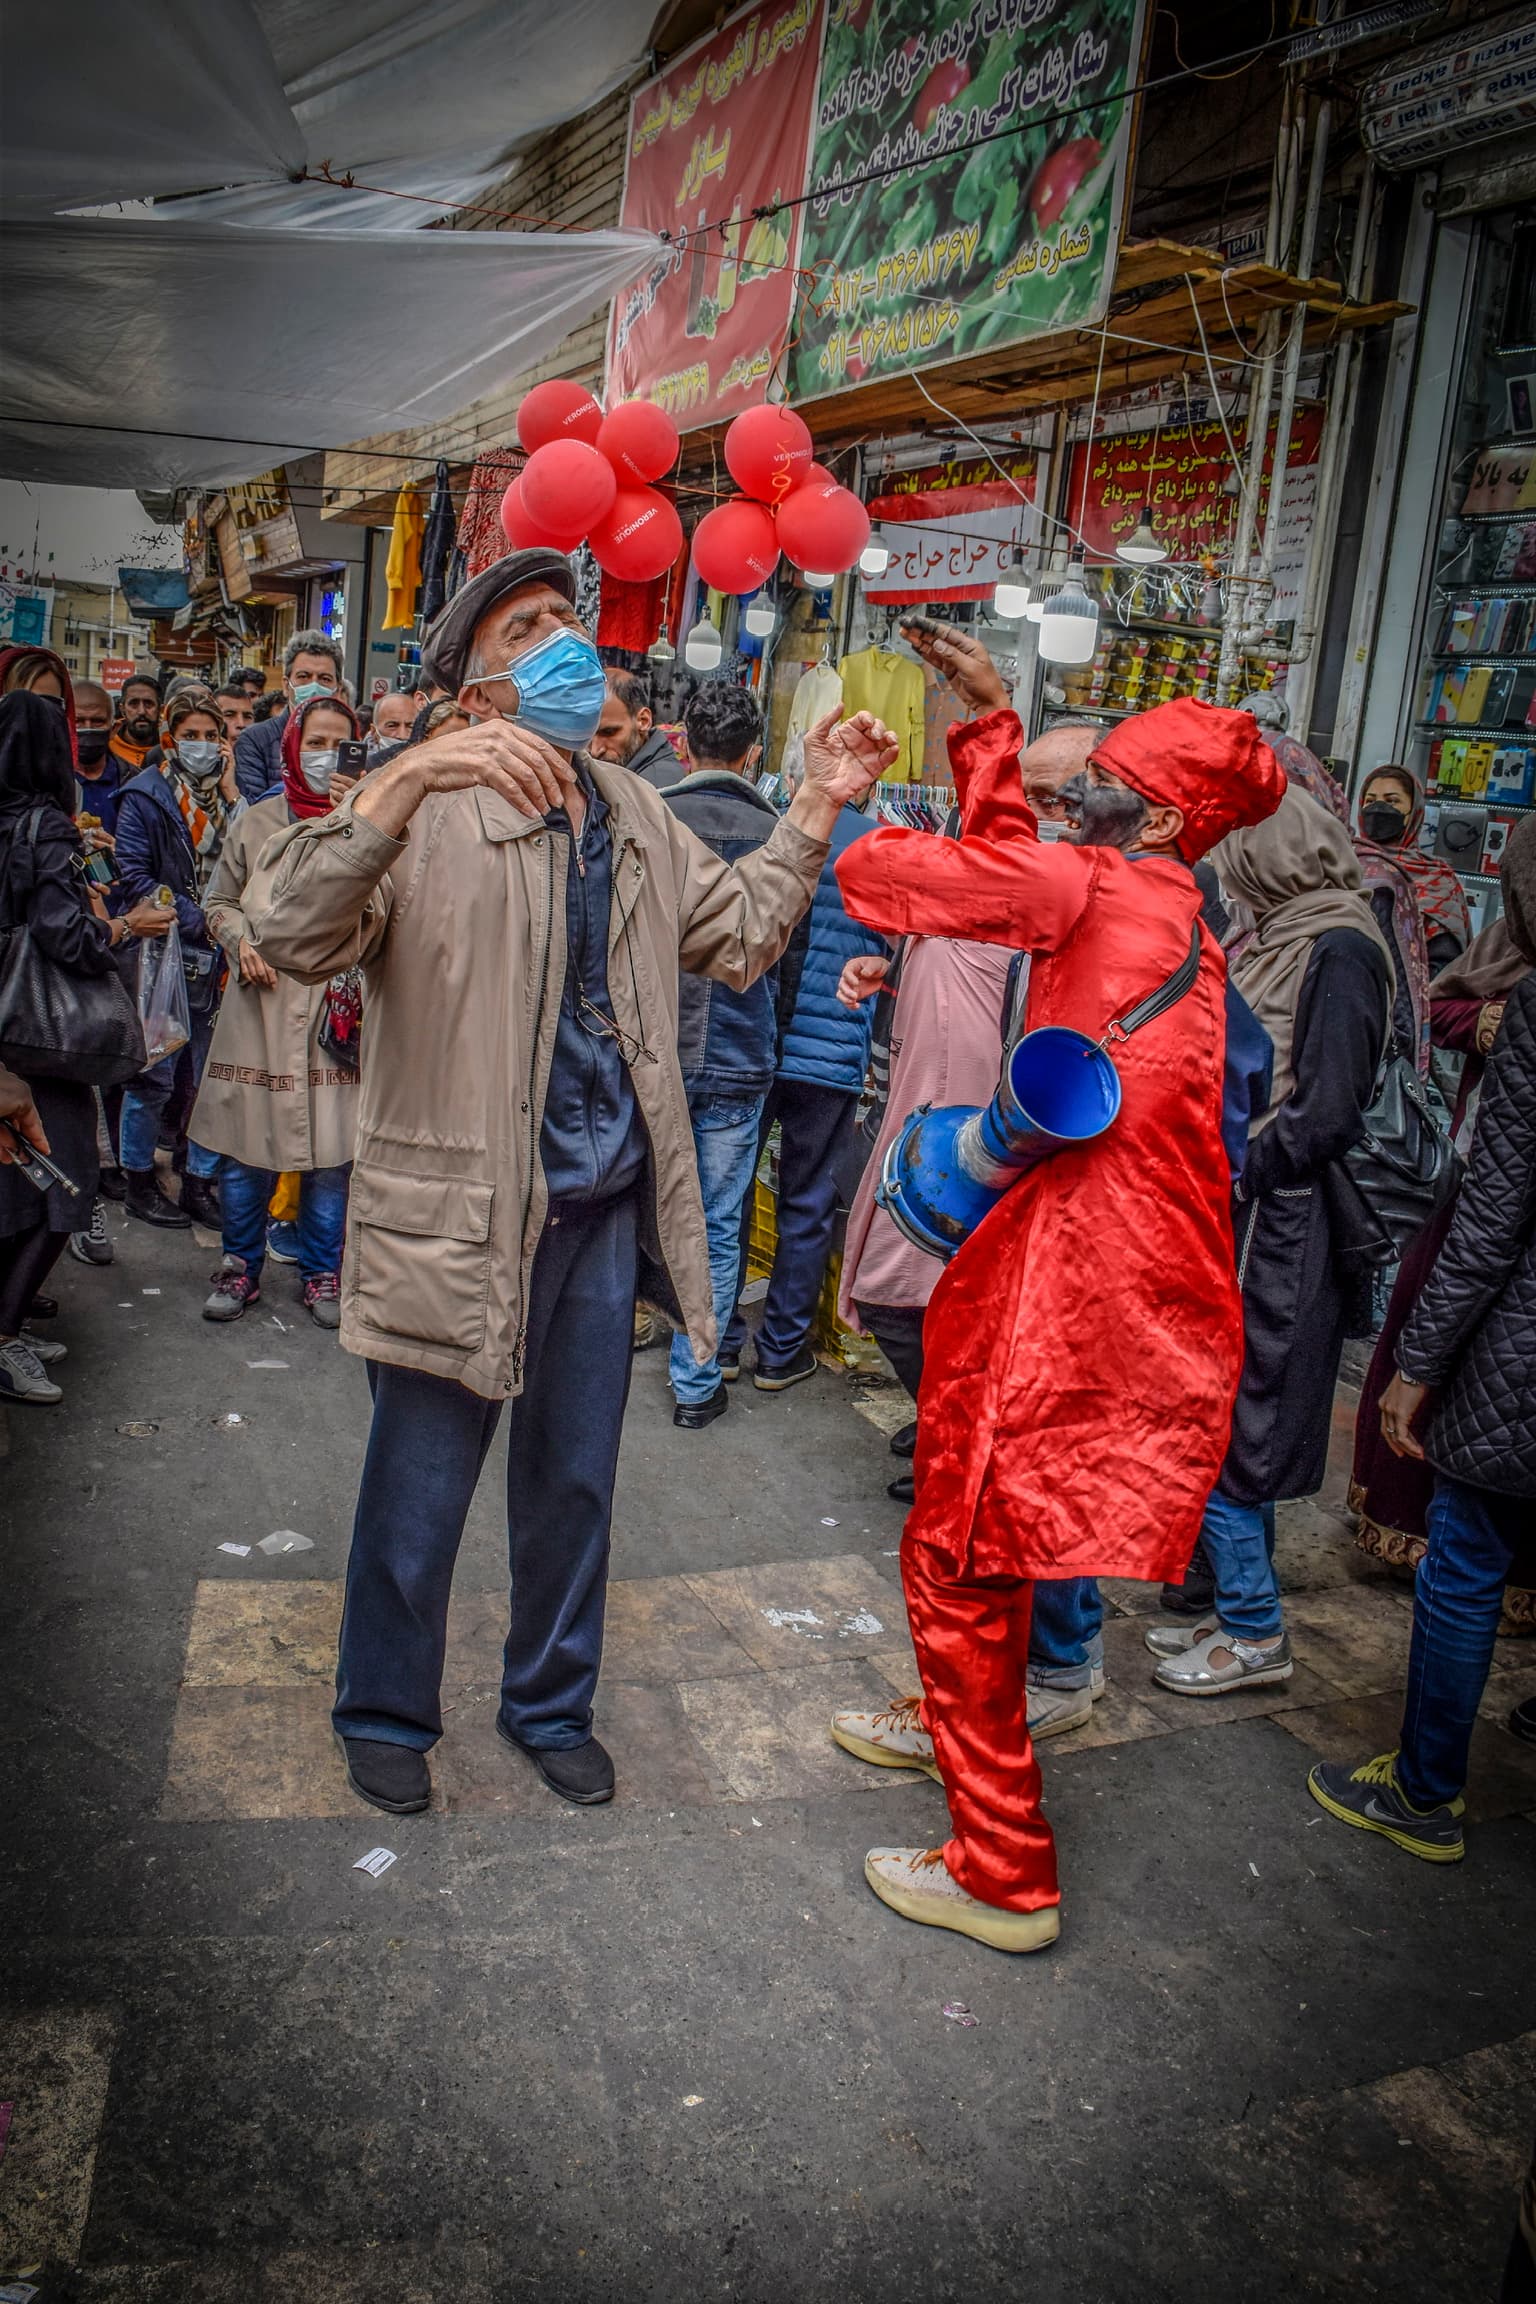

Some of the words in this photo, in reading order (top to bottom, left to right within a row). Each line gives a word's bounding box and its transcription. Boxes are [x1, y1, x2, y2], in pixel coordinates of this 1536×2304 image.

[752, 28, 769, 76] و
[895, 31, 927, 97] خرد
[1020, 29, 1108, 110] سفارشات
[820, 65, 862, 130] آماده
[858, 48, 897, 112] کرده
[980, 64, 1022, 137] کلی
[675, 123, 731, 208] بازار
[994, 241, 1037, 292] تماس
[1041, 224, 1090, 276] شماره
[819, 300, 960, 376] ۰۲۱-۲۶۸۵۱۵۶۰
[1093, 457, 1113, 480] رقم
[1116, 460, 1138, 473] همه
[1141, 451, 1177, 472] خشک
[1474, 461, 1502, 495] بالا
[1508, 465, 1530, 495] به
[1153, 478, 1177, 504] داغ
[1178, 477, 1198, 502] پیاز
[613, 507, 659, 545] VERONIQUE
[1151, 508, 1179, 531] سرخ
[1190, 503, 1222, 529] کبابی
[904, 540, 945, 580] حراج
[949, 536, 989, 577] حراج
